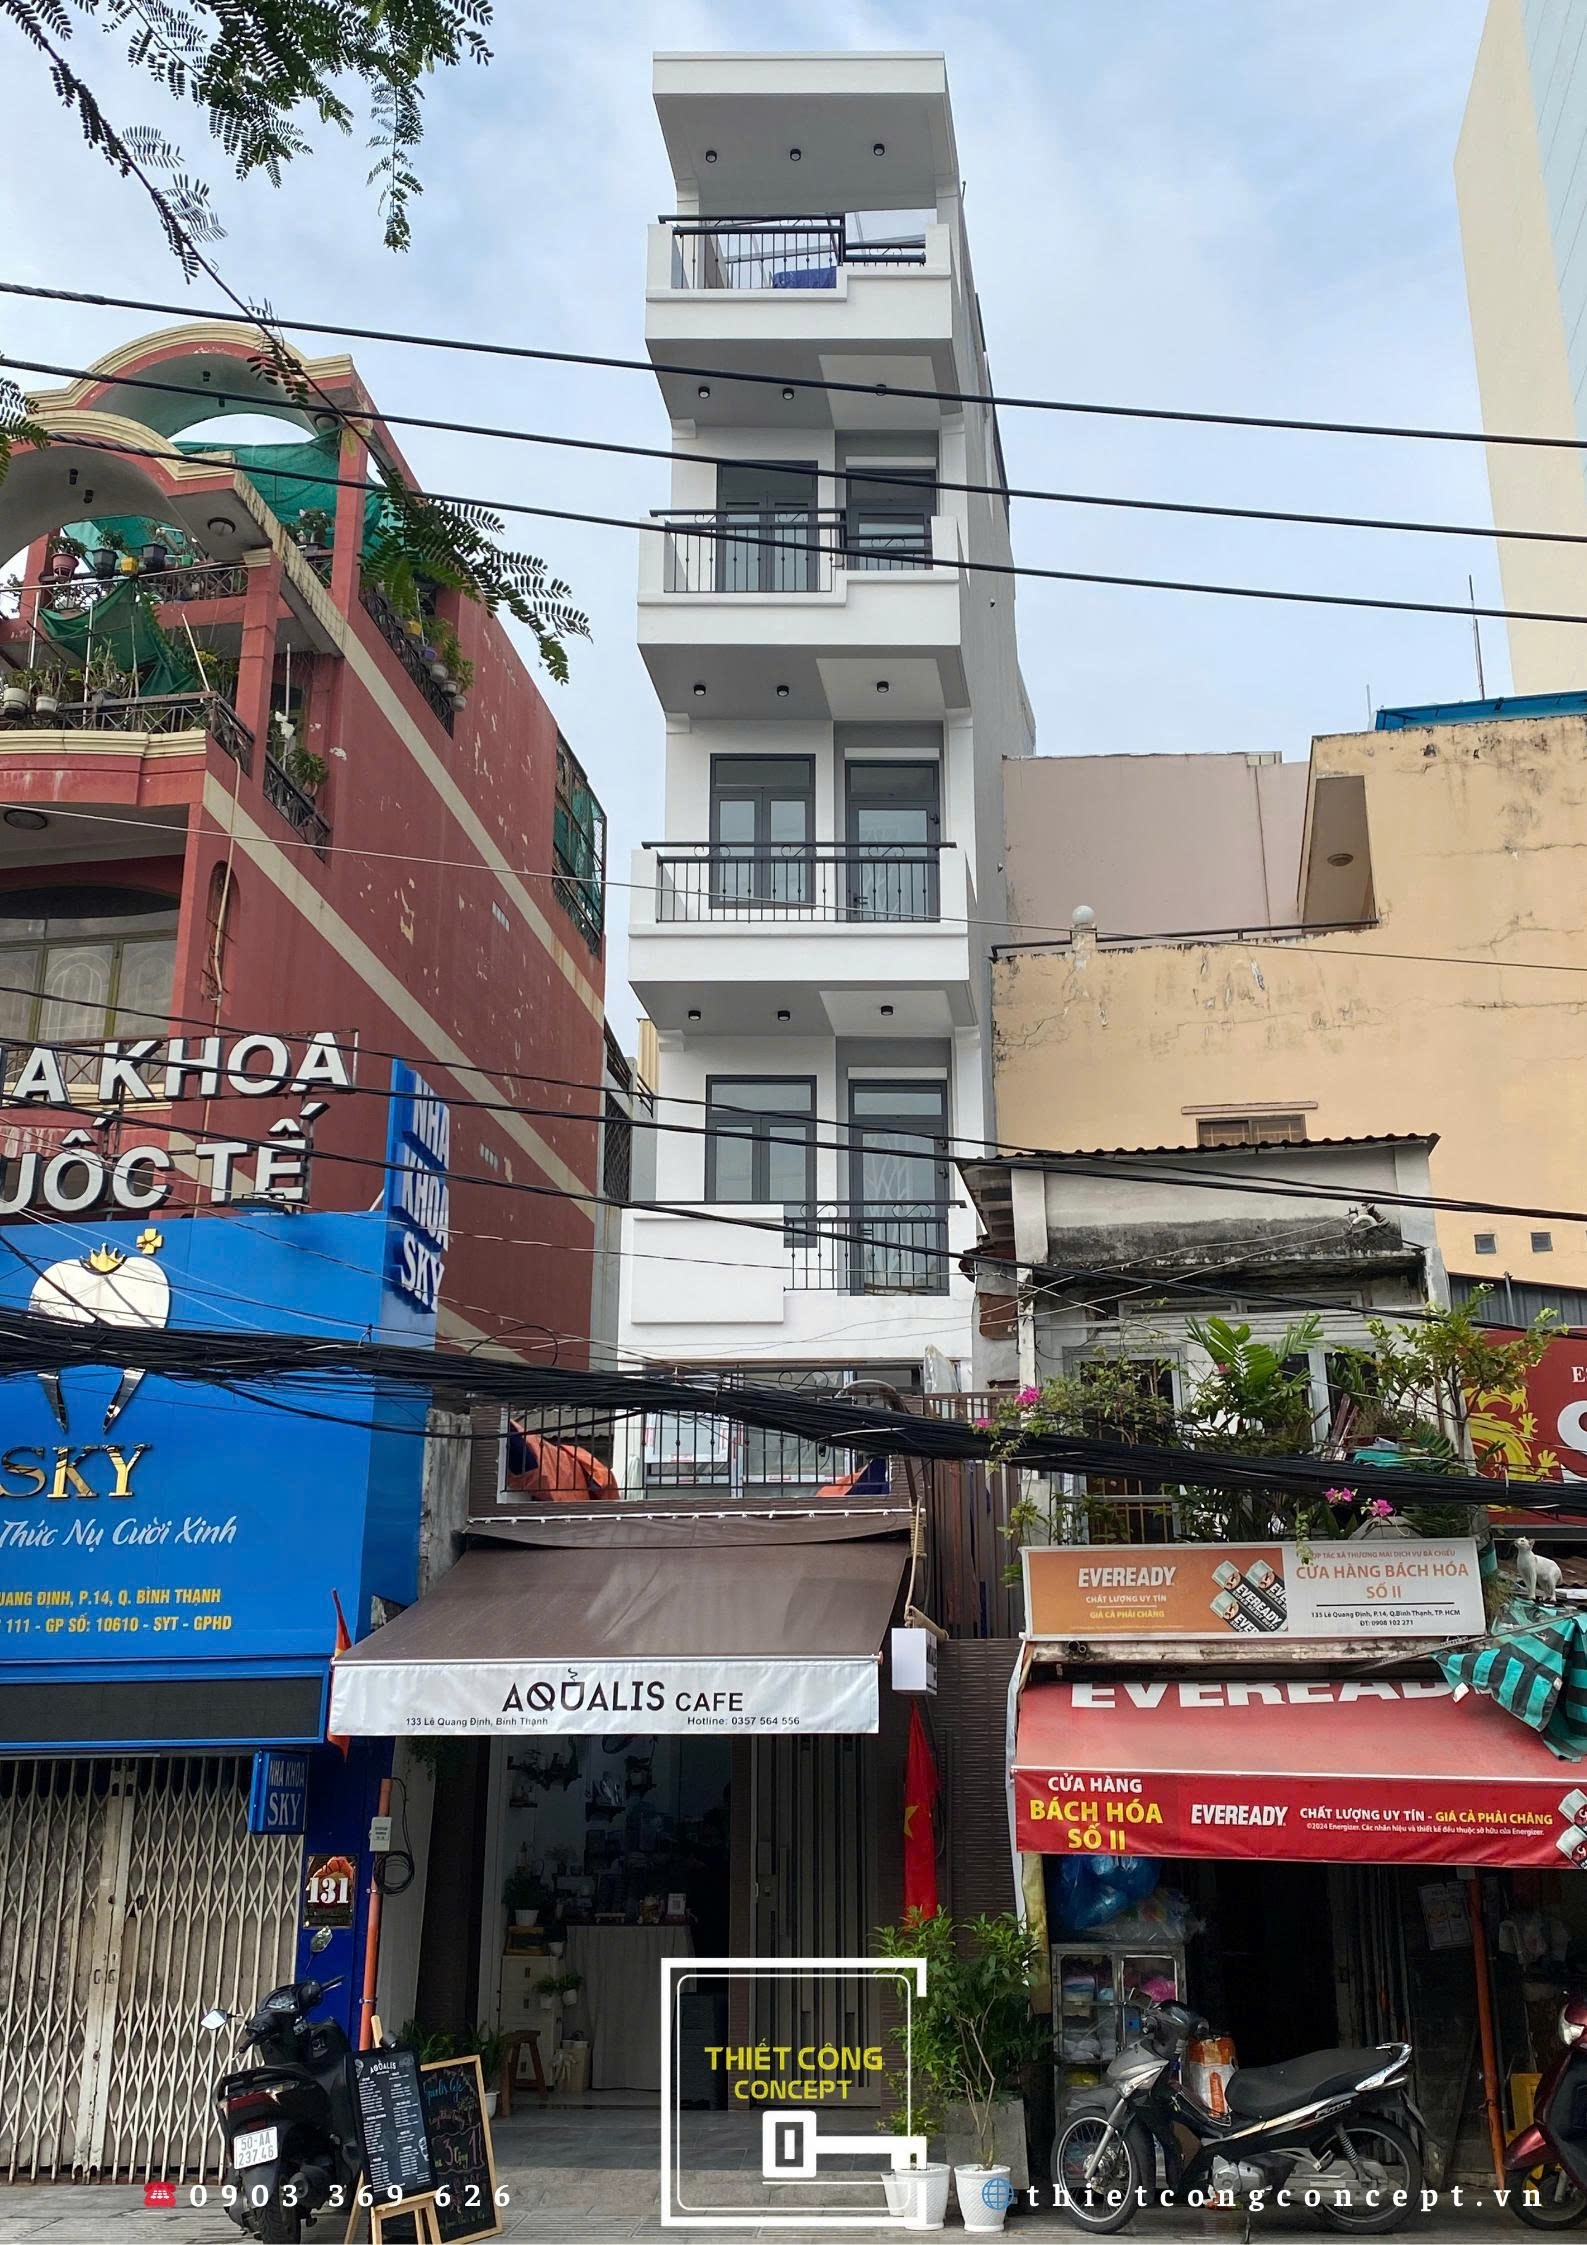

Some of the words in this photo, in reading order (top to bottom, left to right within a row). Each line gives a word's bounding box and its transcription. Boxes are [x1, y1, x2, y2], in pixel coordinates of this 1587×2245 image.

[99, 1031, 353, 1101] KHOA
[413, 1073, 449, 1171] NHA
[195, 1101, 328, 1204] TẾ
[401, 1141, 449, 1251] KHOA
[400, 1231, 445, 1314] SKY
[0, 1443, 151, 1499] SKY
[0, 1518, 59, 1549] Thức
[62, 1517, 104, 1553] Nụ
[112, 1516, 173, 1545] Cười
[174, 1514, 238, 1546] Xinh
[1078, 1566, 1176, 1588] EVEREADY
[1333, 1563, 1381, 1579] HÀNG
[1385, 1561, 1429, 1577] BÁCH
[1432, 1560, 1469, 1577] HÓA
[37, 1590, 74, 1609] ĐỊNH,
[118, 1589, 132, 1607] Q.
[136, 1586, 170, 1605] BÌNH
[174, 1587, 222, 1607] THẠNH
[1139, 1594, 1151, 1603] UY
[1366, 1581, 1388, 1599] SỐ
[1236, 1583, 1282, 1626] EVEREADY
[45, 1617, 65, 1633] GP
[68, 1612, 91, 1633] SỐ:
[96, 1616, 139, 1633] 10610
[153, 1616, 179, 1632] SYT
[193, 1614, 232, 1631] GPHD
[502, 1680, 665, 1713] AQUALIS
[675, 1692, 743, 1712] CAFE
[405, 1717, 422, 1727] 133
[424, 1716, 435, 1726] Lê
[437, 1717, 468, 1728] Quang
[469, 1716, 493, 1728] Định,
[519, 1716, 549, 1728] Thạnh
[687, 1716, 728, 1726] Hotline:
[731, 1716, 757, 1726] 0357
[760, 1716, 778, 1726] 564
[781, 1716, 801, 1726] 556
[269, 1760, 284, 1787] NHA
[285, 1760, 305, 1788] KHOA
[1048, 1773, 1085, 1791] CỬA
[1090, 1775, 1143, 1793] HÀNG
[267, 1791, 301, 1826] SKY
[1030, 1797, 1098, 1822] BÁCH
[1106, 1798, 1163, 1824] HÓA
[1191, 1804, 1288, 1826] EVEREADY
[1300, 1805, 1331, 1819] CHẤT
[1335, 1808, 1380, 1823] LƯỢNG
[1383, 1810, 1401, 1821] UY
[1404, 1809, 1425, 1822] TÍN
[1435, 1810, 1457, 1822] GIÁ
[1459, 1809, 1475, 1823] CẢ
[1478, 1809, 1507, 1823] PHẢI
[1510, 1812, 1553, 1825] CHĂNG
[1068, 1823, 1102, 1850] SỐ
[1329, 1823, 1361, 1832] Energizer.
[308, 1877, 349, 1904] 131
[241, 2132, 271, 2151] 50-AA
